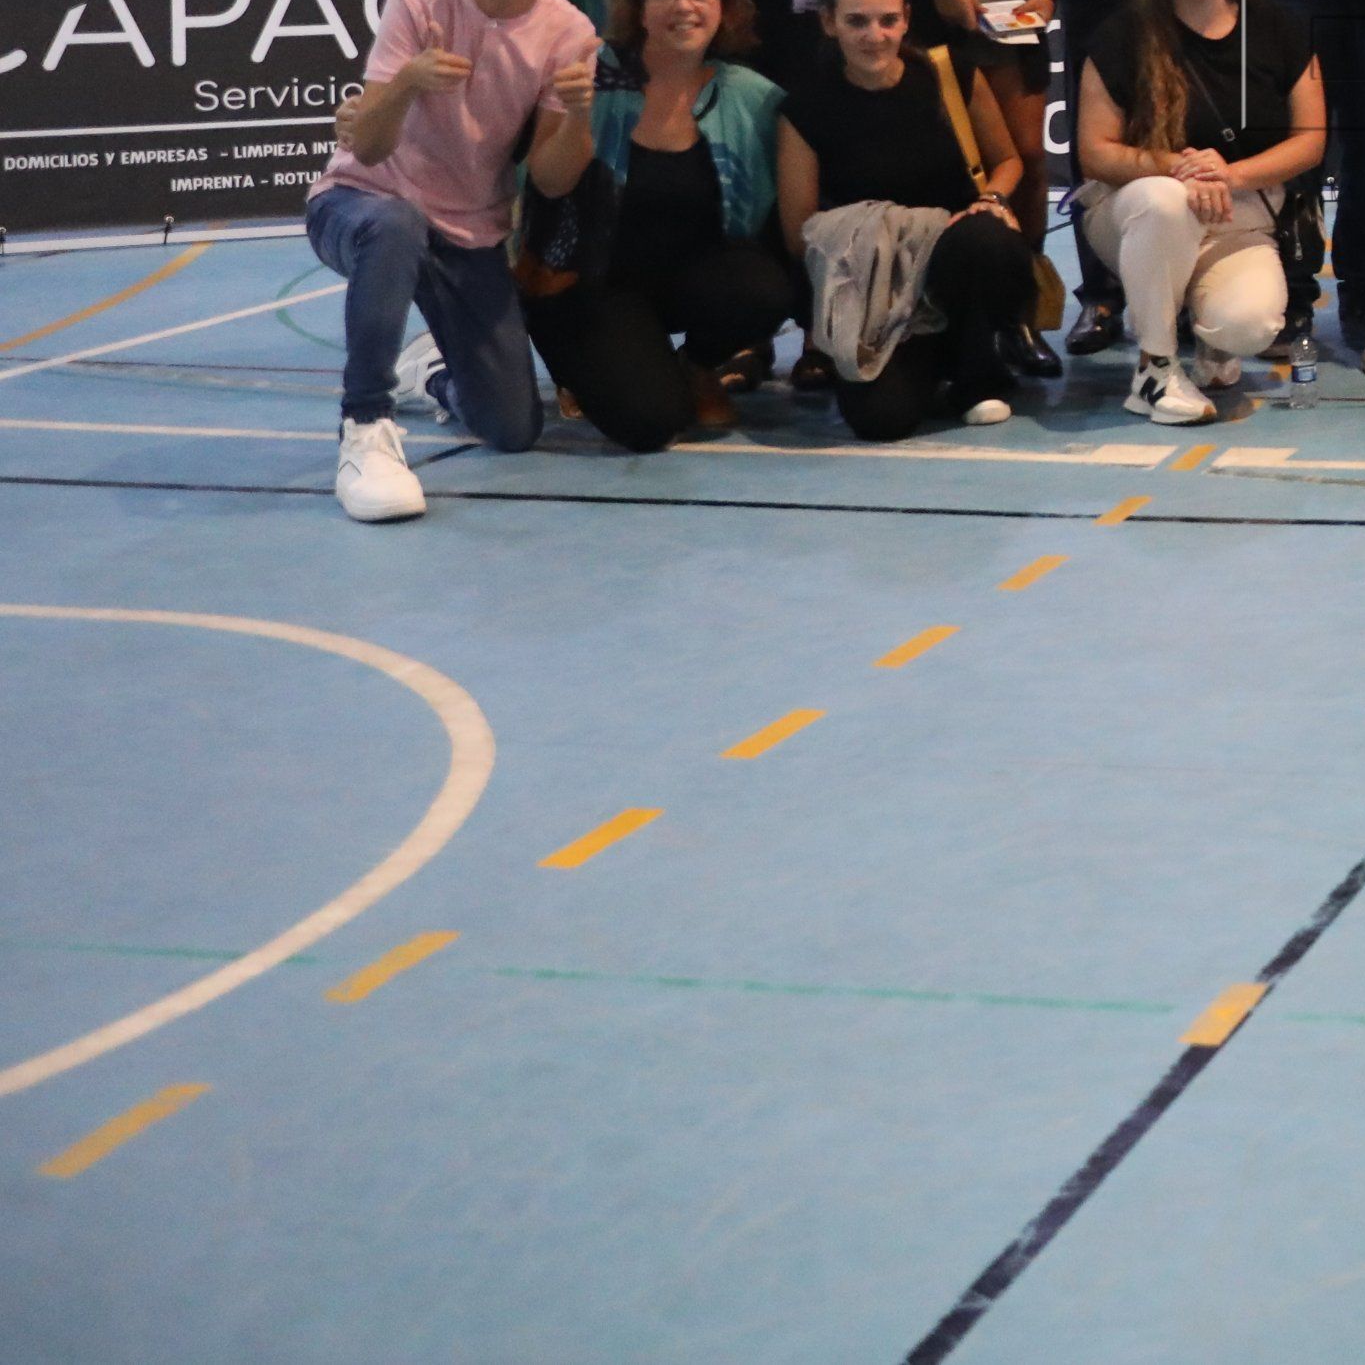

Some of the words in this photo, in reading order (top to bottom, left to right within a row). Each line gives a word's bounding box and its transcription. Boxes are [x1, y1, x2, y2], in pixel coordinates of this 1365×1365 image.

[4, 153, 99, 171] DOMICILIOS
[105, 152, 116, 166] Y
[120, 148, 208, 166] EMPRESAS
[233, 142, 307, 159] LIMPIEZA
[171, 175, 255, 192] IMPRENTA
